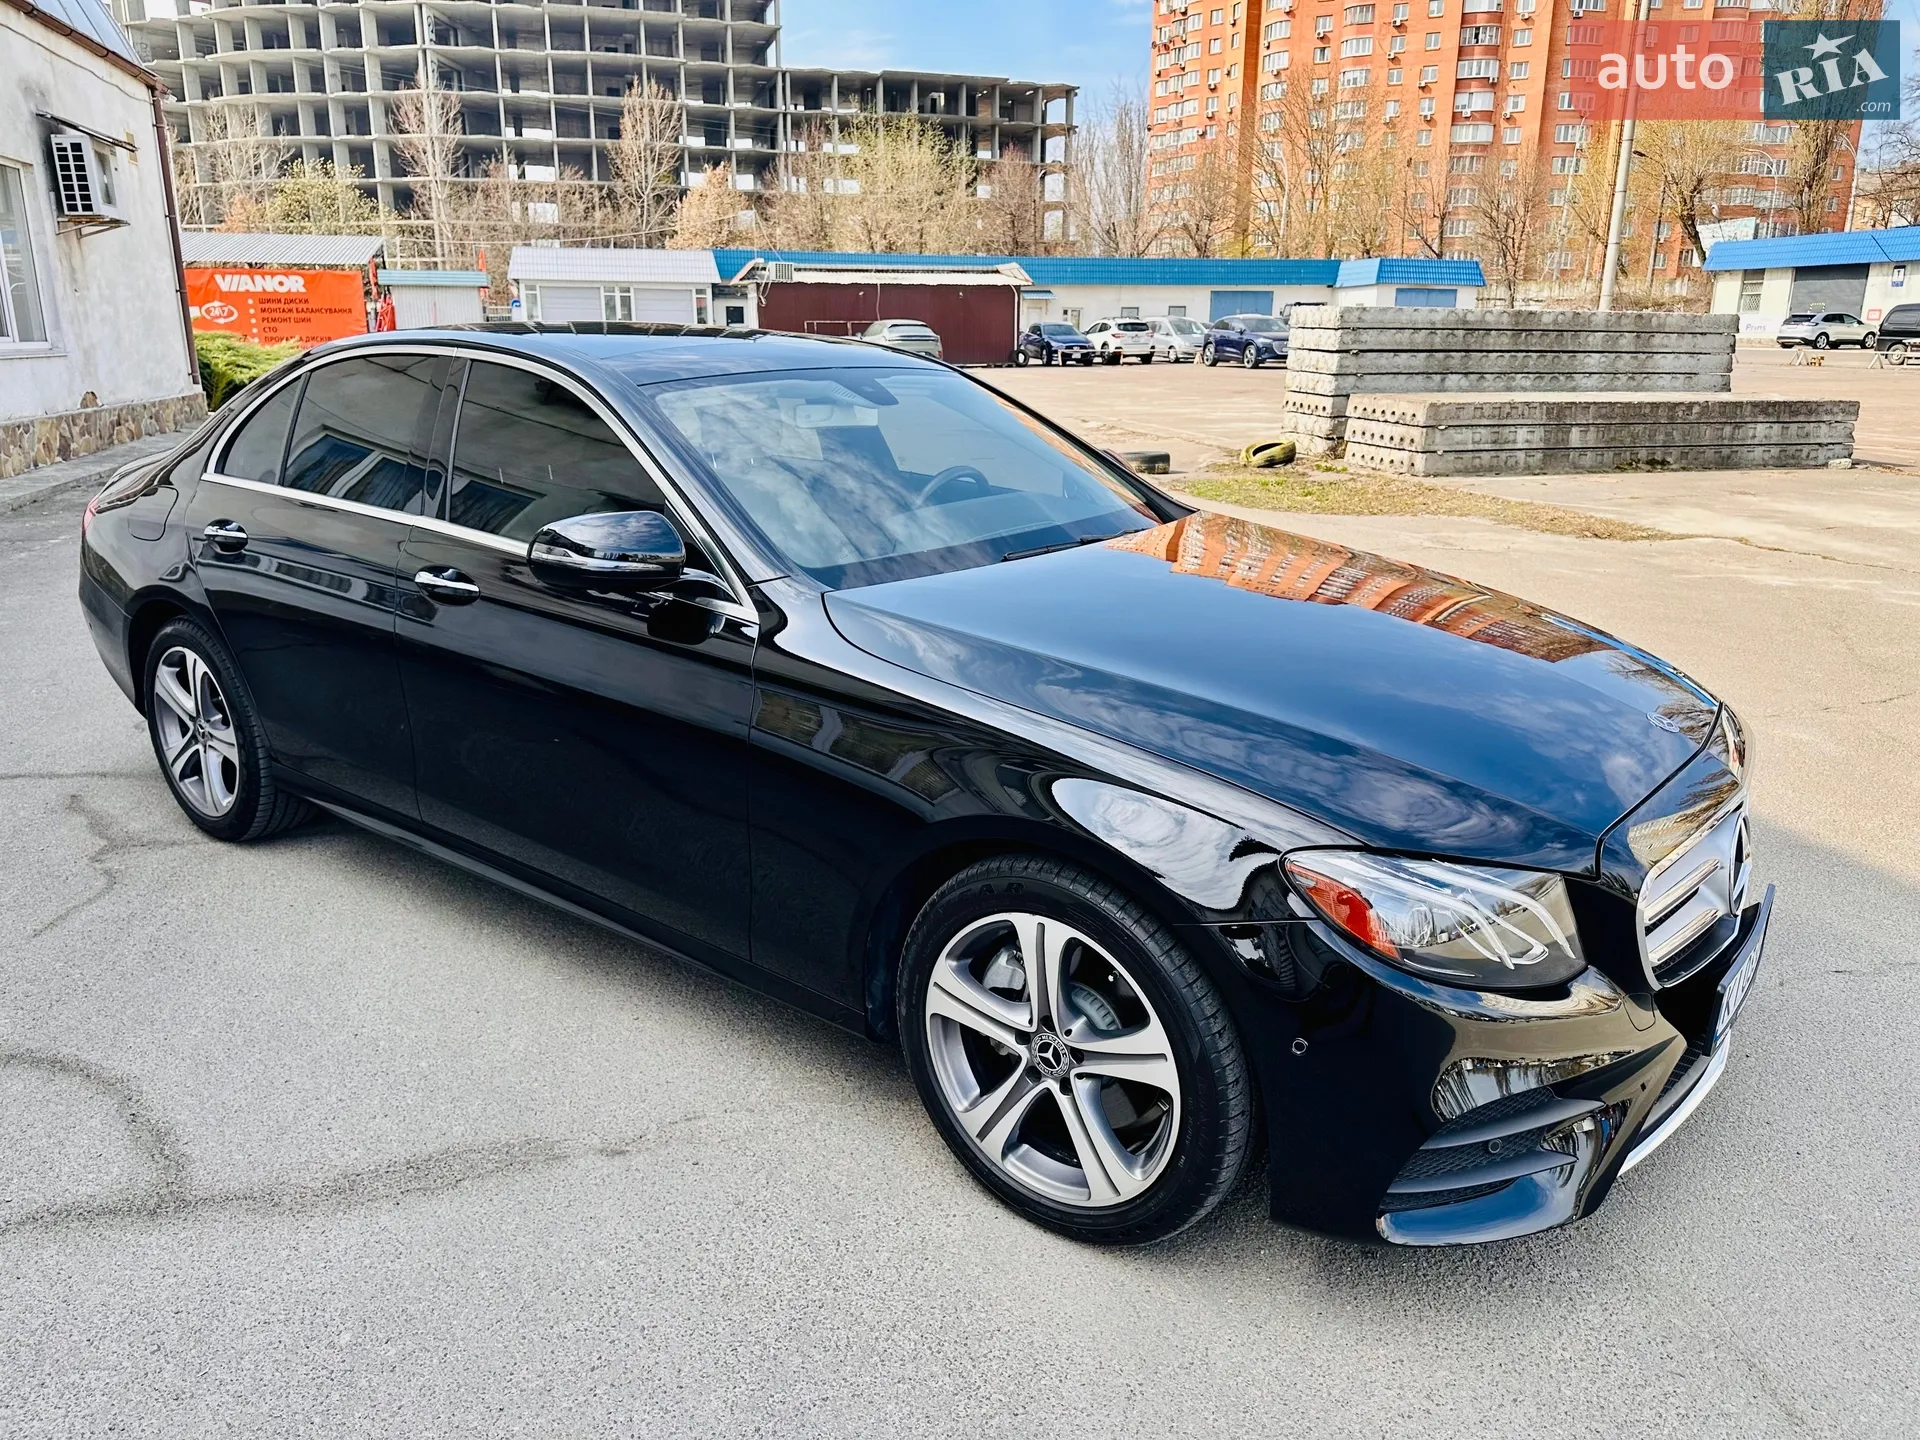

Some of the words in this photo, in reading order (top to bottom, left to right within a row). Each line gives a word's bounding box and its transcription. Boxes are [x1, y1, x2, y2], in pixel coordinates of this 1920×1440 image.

[214, 274, 306, 292] VIANOR
[258, 297, 282, 305] ШИНИ
[284, 297, 310, 306] ДИСКИ
[295, 307, 353, 315] БАЛАНСУВАННЯ
[261, 316, 292, 324] РЕМОНТ
